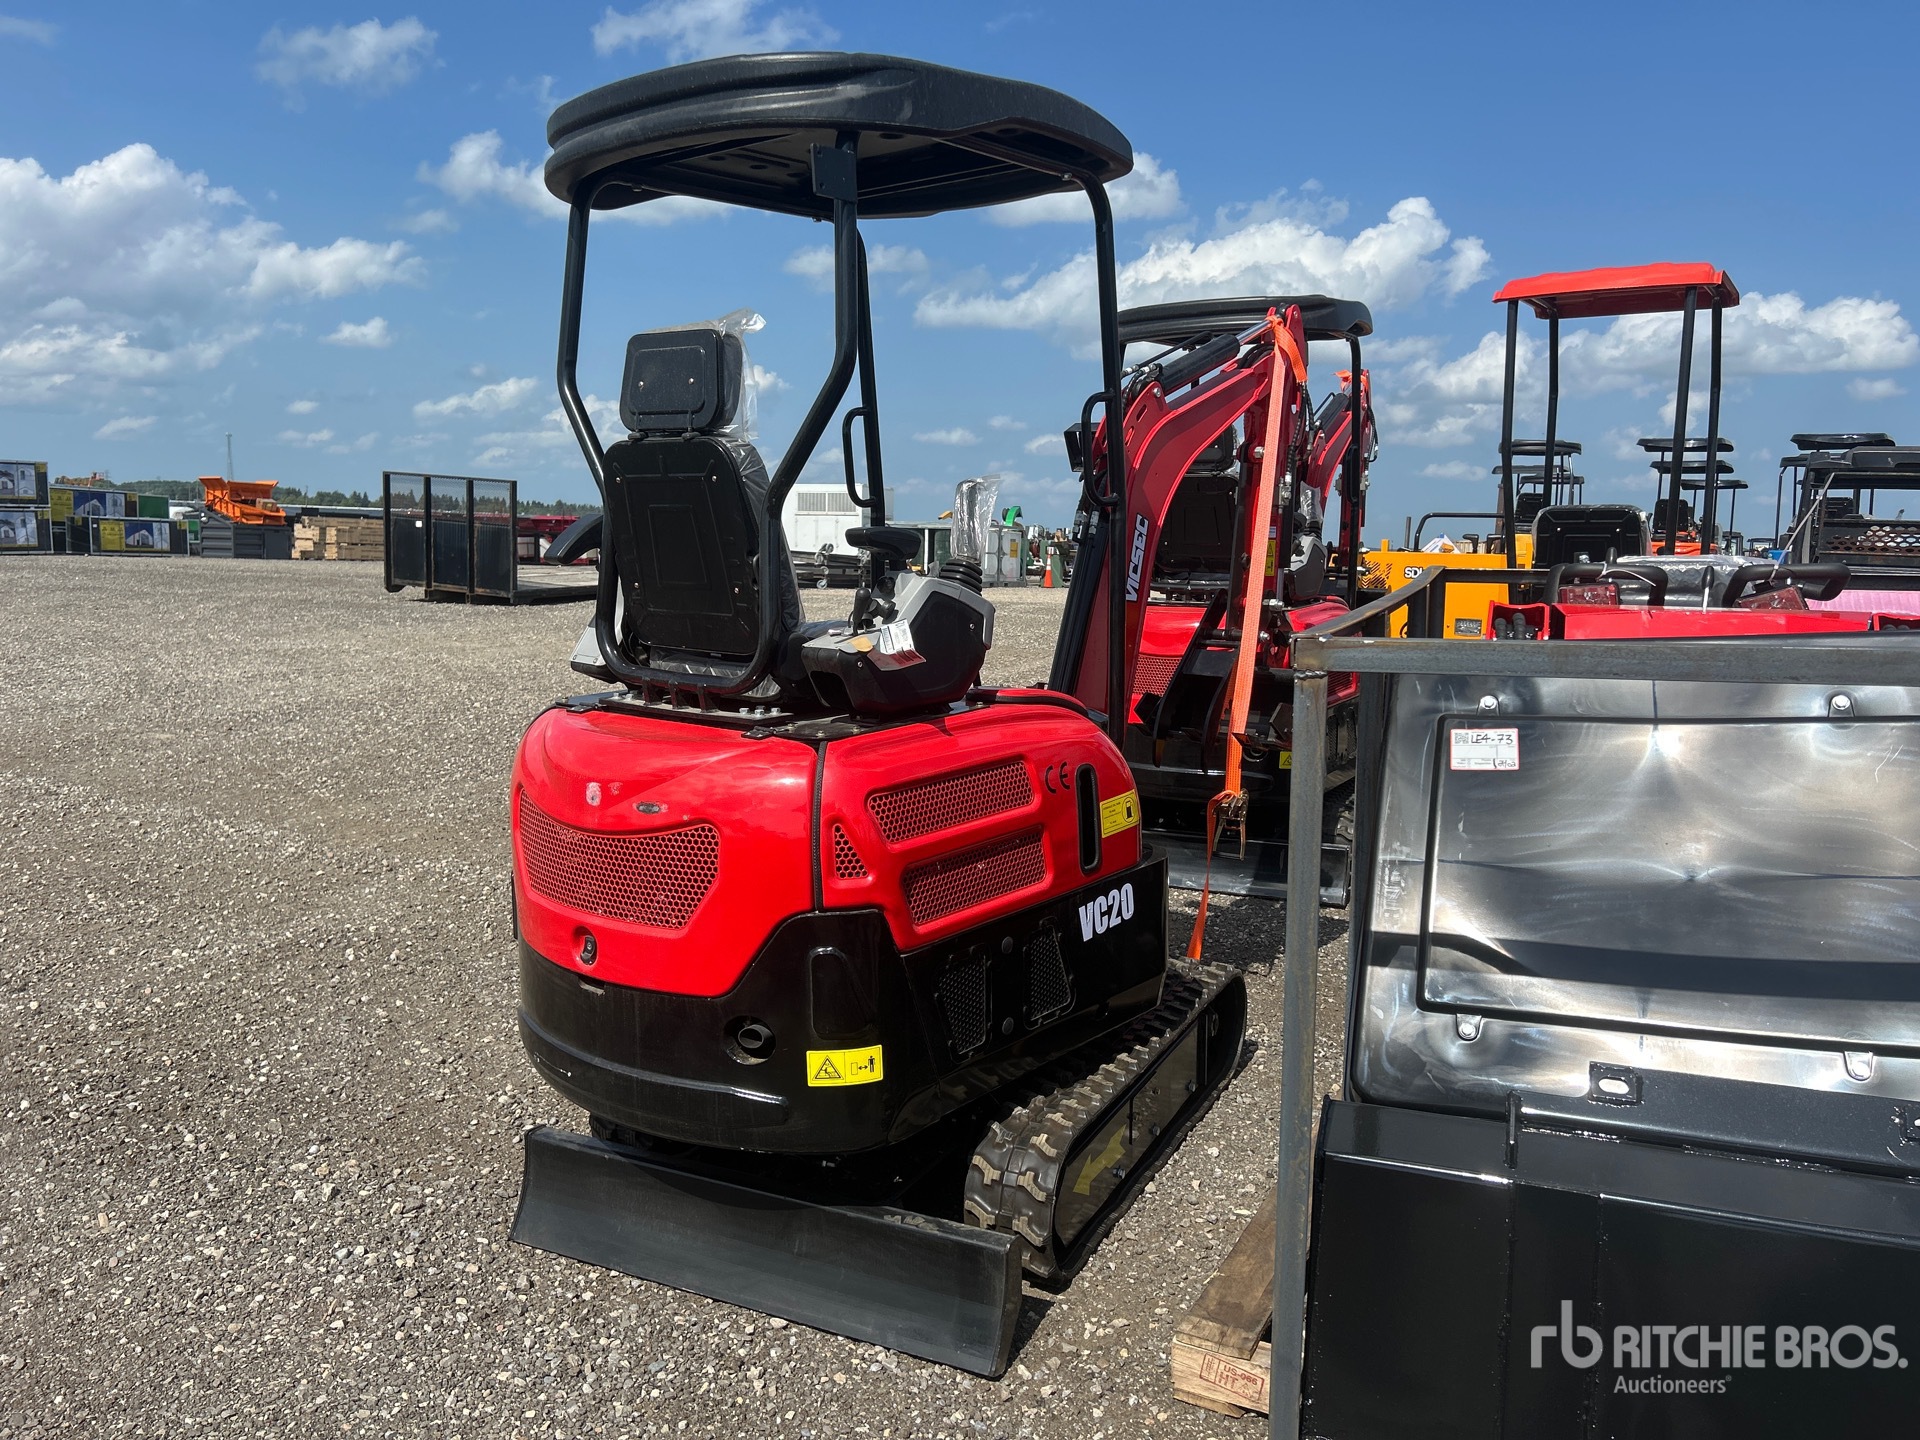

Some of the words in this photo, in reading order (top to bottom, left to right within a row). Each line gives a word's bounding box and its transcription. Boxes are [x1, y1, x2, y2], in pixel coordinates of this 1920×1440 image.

[1125, 513, 1149, 601] VICSEC
[1471, 733, 1513, 745] LE4-73
[1078, 882, 1135, 943] VC20
[1218, 1371, 1239, 1389] HT
